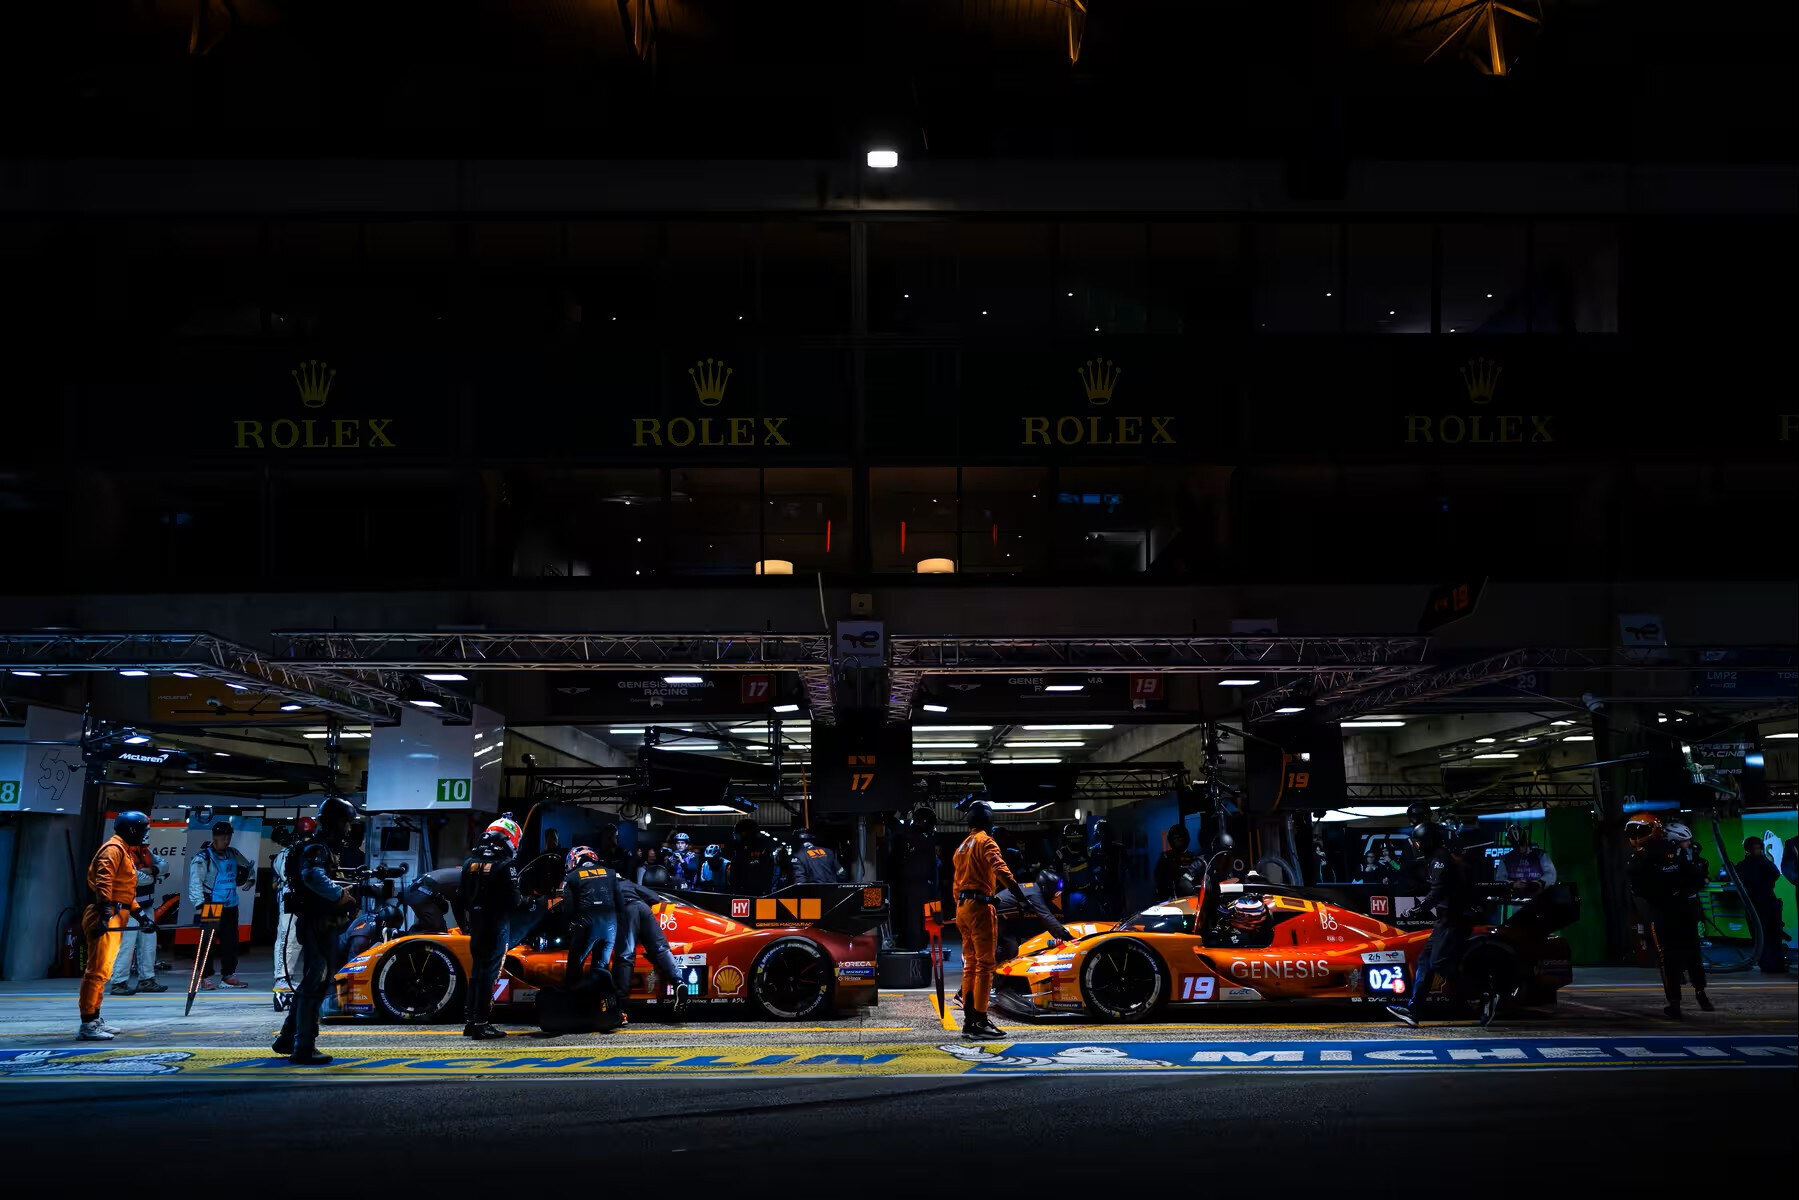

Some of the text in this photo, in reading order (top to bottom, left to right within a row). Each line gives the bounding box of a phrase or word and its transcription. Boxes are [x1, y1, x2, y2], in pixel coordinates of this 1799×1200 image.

[234, 418, 396, 449] ROLEX
[633, 417, 791, 447] ROLEX
[1021, 416, 1176, 446] ROLEX
[1405, 414, 1554, 443] ROLEX
[1007, 677, 1045, 685] GENES
[1707, 671, 1737, 680] LMP2
[617, 681, 668, 689] GENESIS
[643, 688, 689, 696] RACING
[749, 681, 769, 697] 17
[1135, 678, 1158, 693] 19
[117, 752, 165, 763] McLaren
[851, 773, 875, 791] 17
[1288, 772, 1310, 788] 19
[442, 780, 469, 799] 10
[733, 902, 748, 914] HY
[1372, 900, 1387, 911] HY
[1230, 959, 1330, 979] GENESIS
[1182, 976, 1216, 999] 19
[210, 1053, 902, 1069] MICHELIN
[1189, 1046, 1798, 1062] MICHELIN
